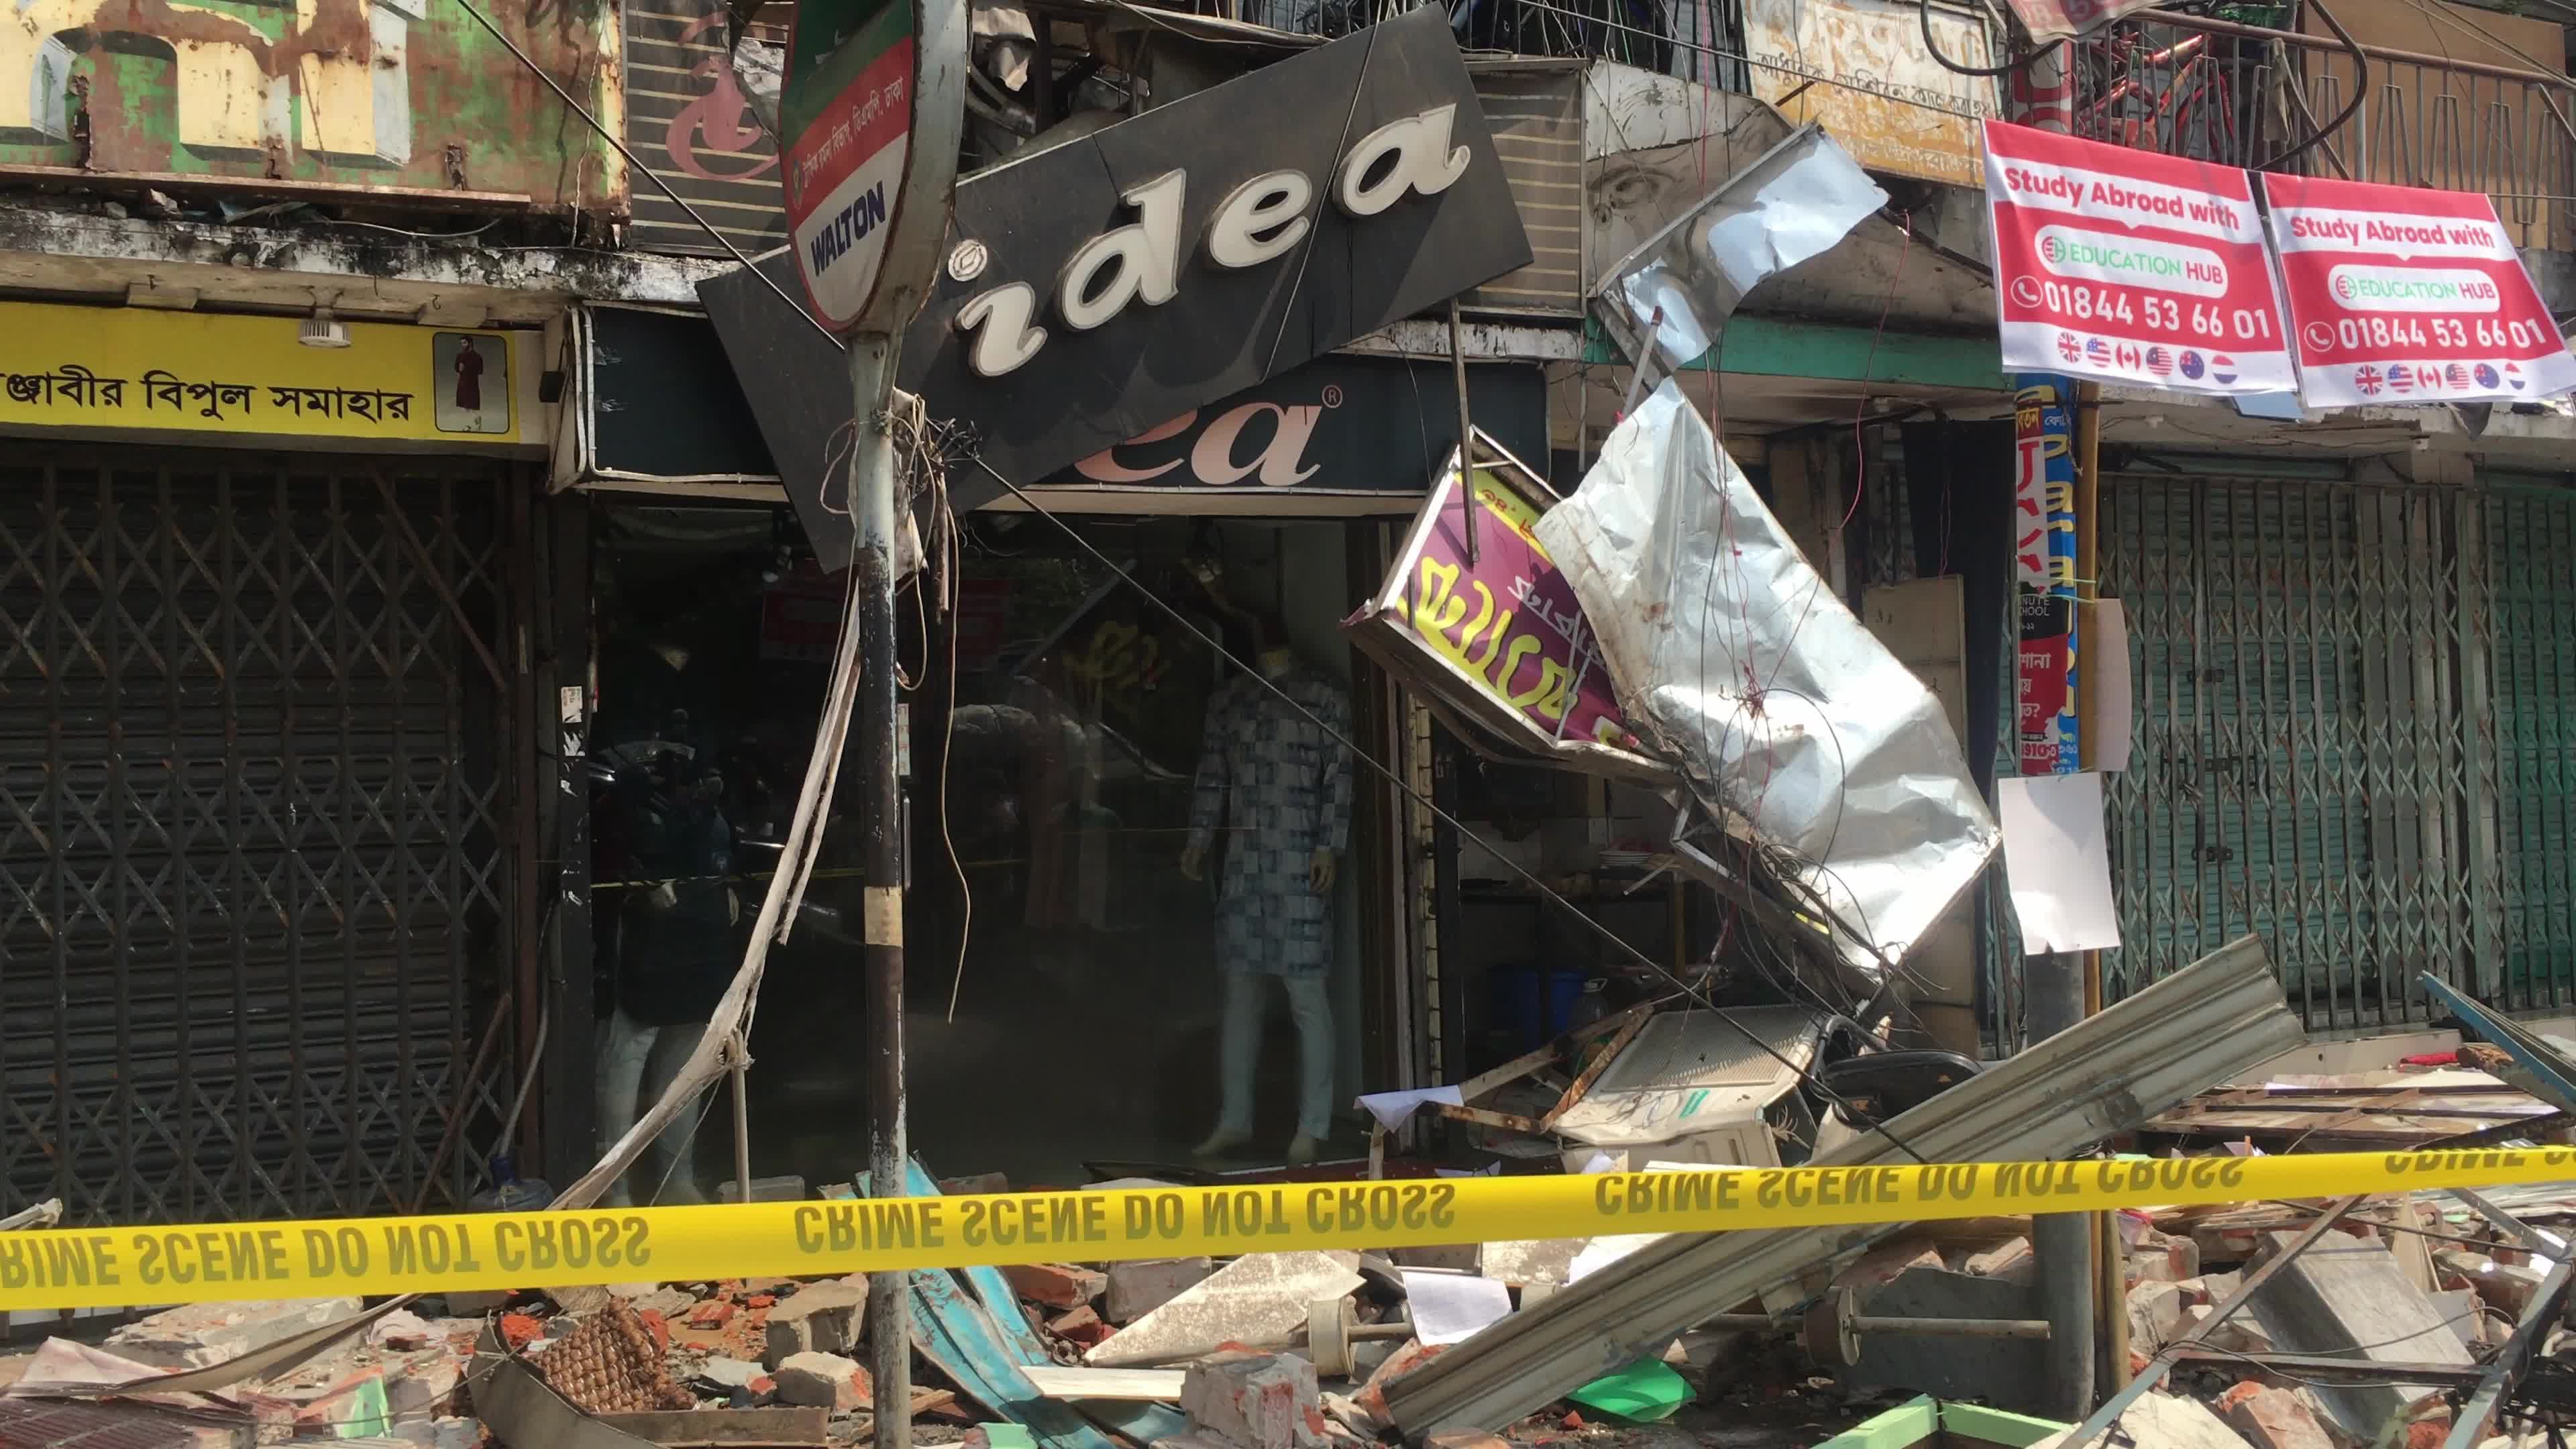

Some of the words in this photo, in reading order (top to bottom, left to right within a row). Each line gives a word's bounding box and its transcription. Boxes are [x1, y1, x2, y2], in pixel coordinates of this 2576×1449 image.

[2003, 165, 2083, 205] Study
[2091, 182, 2184, 218] Abroad
[2189, 194, 2241, 231] with
[809, 180, 886, 277] WALTON
[948, 102, 1471, 377] idea
[2292, 216, 2359, 247] Study
[2365, 219, 2443, 247] Abroad
[2447, 225, 2495, 250] with
[2070, 244, 2182, 276] EDUCATION
[2186, 260, 2224, 284] HUB
[2359, 277, 2457, 300] EDUCATION
[2459, 280, 2496, 300] HUB
[2043, 280, 2134, 325] 01844
[2144, 294, 2181, 331] 53
[2191, 302, 2224, 339] 66
[2233, 308, 2271, 340] 01
[2339, 318, 2426, 348] 01844
[2431, 317, 2467, 348] 53
[2475, 319, 2506, 347] 66
[2510, 318, 2545, 349] 01
[0, 364, 128, 408] ঞ্জাবীর
[139, 370, 256, 421] বিপুল
[269, 384, 414, 422] সমাহার
